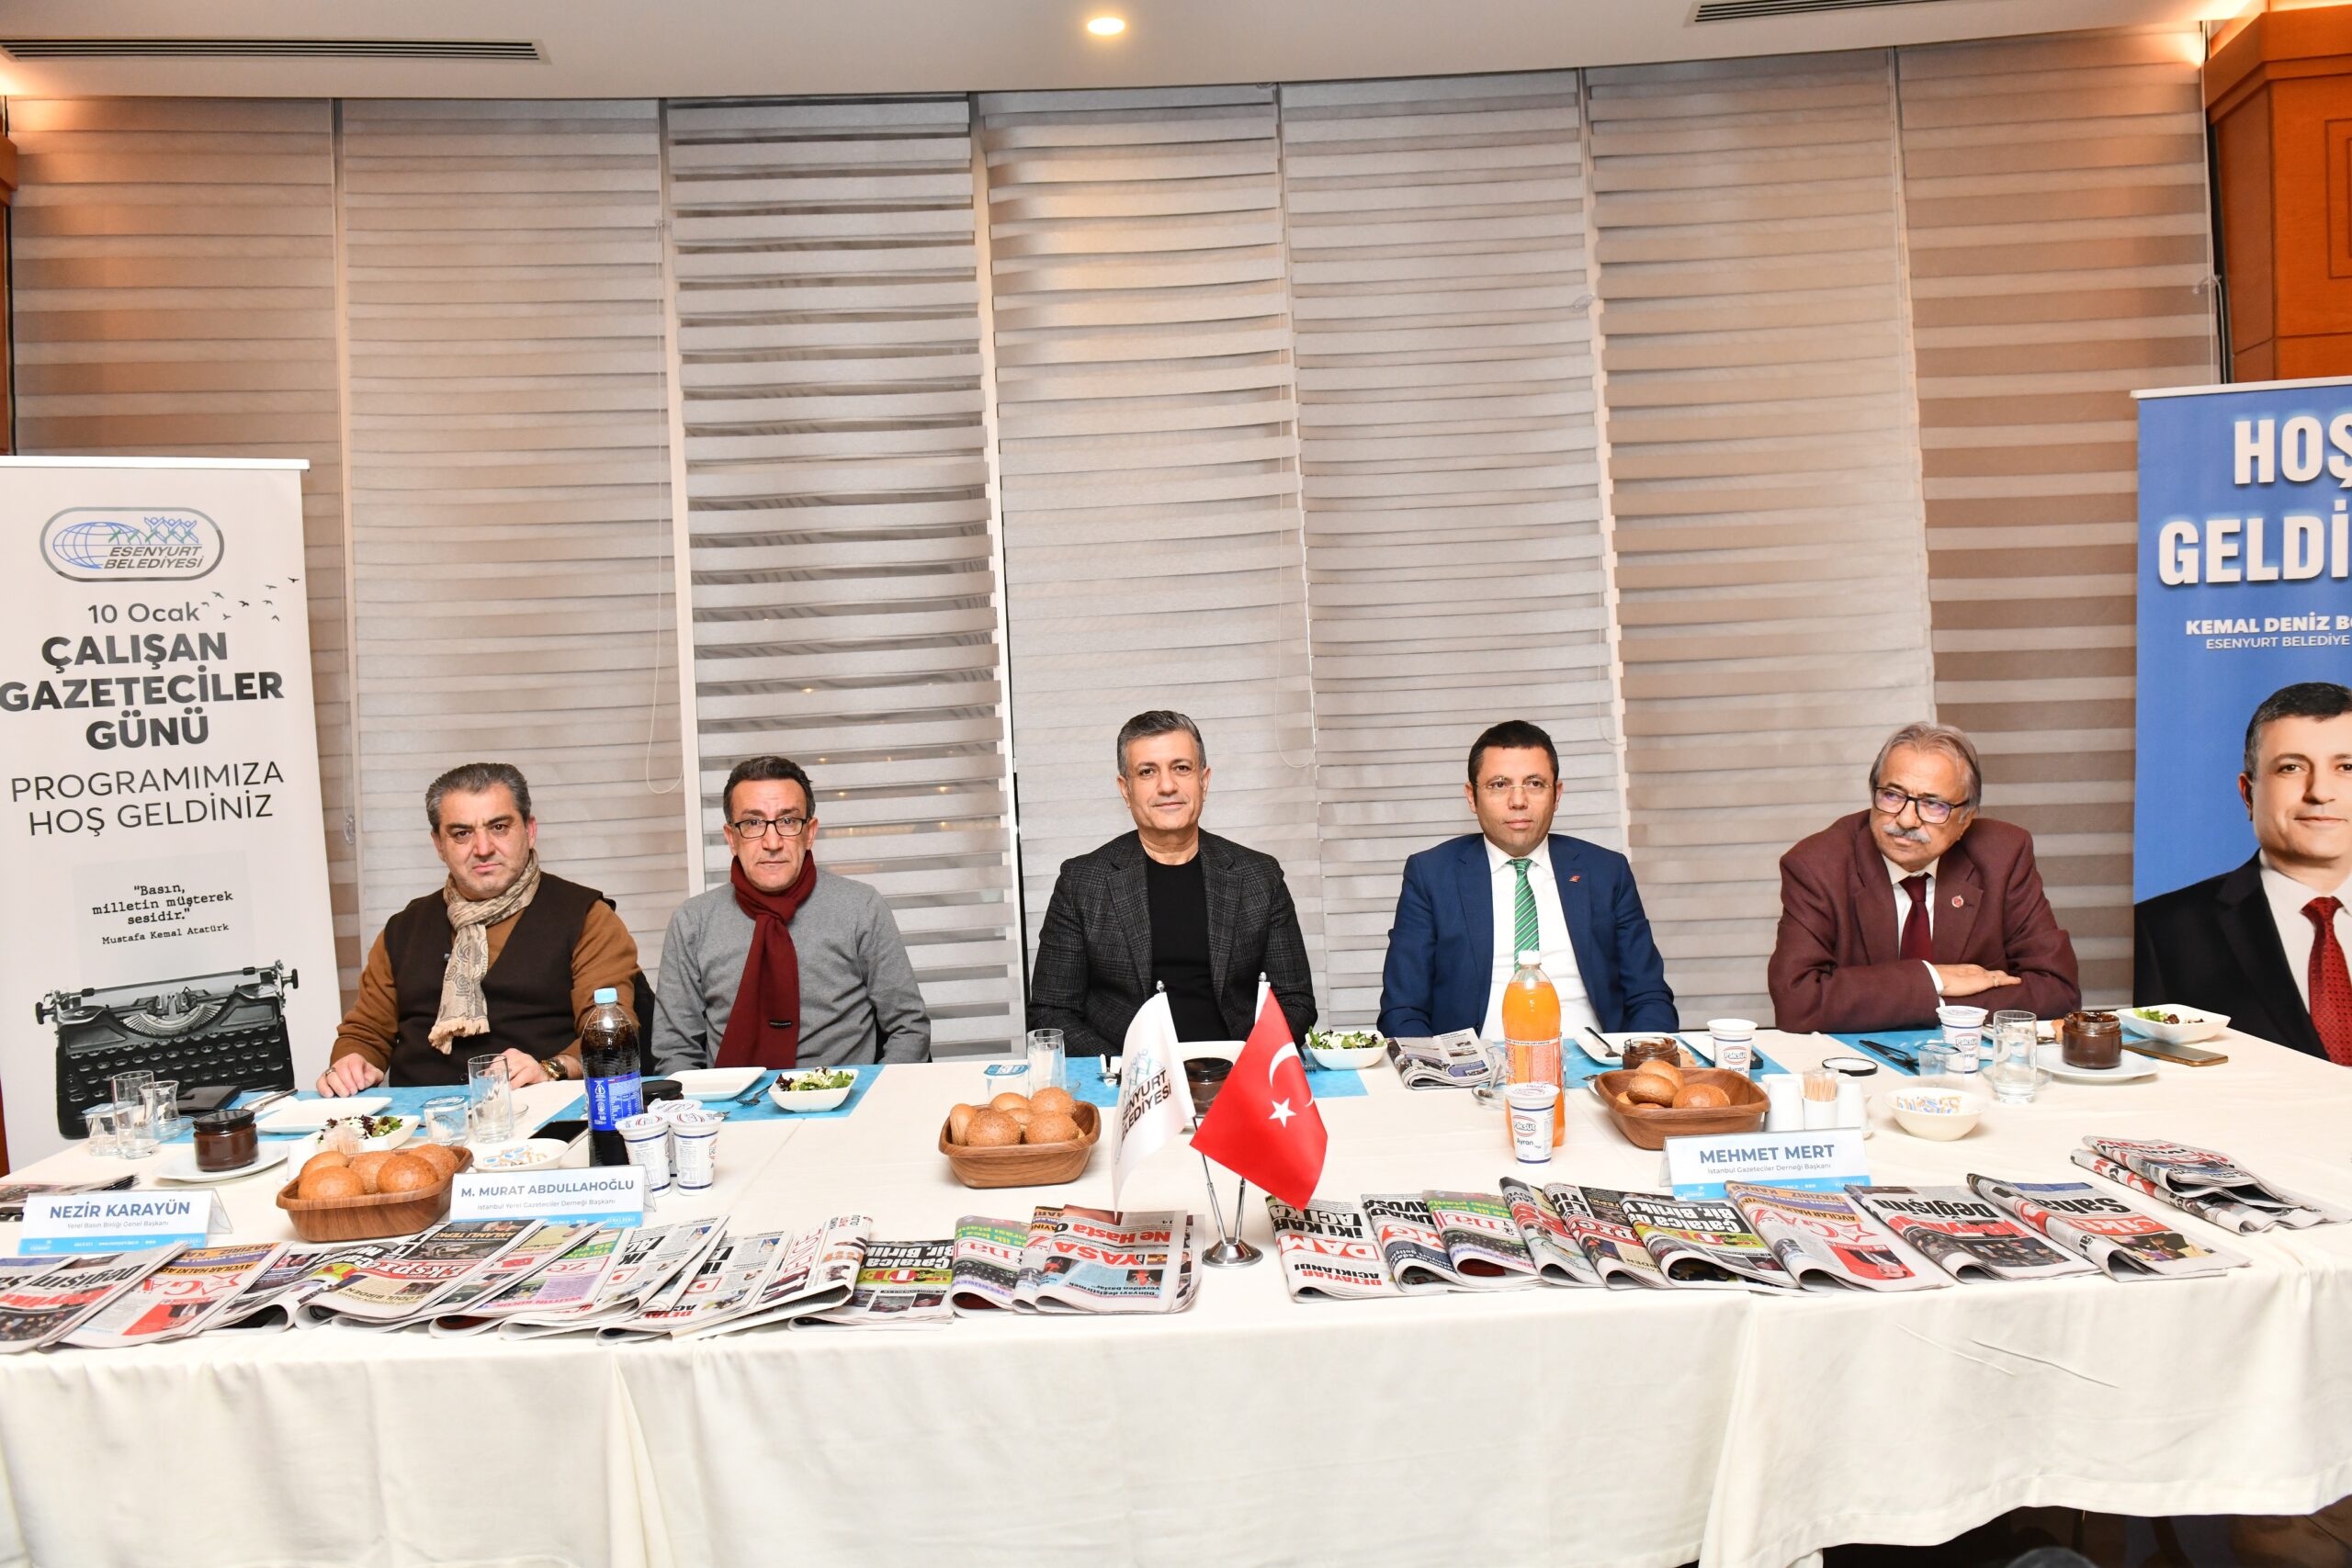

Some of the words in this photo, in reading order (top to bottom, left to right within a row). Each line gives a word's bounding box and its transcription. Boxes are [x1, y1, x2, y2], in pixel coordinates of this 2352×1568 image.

[109, 546, 203, 557] ESENYURT
[2159, 499, 2349, 586] GELDİ
[104, 555, 205, 570] BELEDİYESİ
[88, 604, 118, 624] 10
[128, 602, 200, 623] Ocak
[2186, 617, 2259, 635] KEMAL
[2264, 611, 2330, 632] DENİZ
[2335, 615, 2352, 630] B
[2206, 637, 2278, 649] ESENYURT
[2282, 633, 2350, 647] BELEDİYE
[41, 632, 228, 673] ÇALIŞAN
[0, 665, 285, 712] GAZETECİLER
[85, 706, 209, 750] GÜNÜ
[11, 761, 285, 802] PROGRAMIMIZA
[29, 807, 106, 837] HOŞ
[117, 790, 273, 828] GELDİNİZ
[92, 898, 159, 915] milletin
[166, 891, 233, 908] müşterek
[102, 932, 146, 945] Mustafa
[150, 929, 183, 940] Kemal
[187, 923, 230, 936] Atatürk
[1700, 1146, 1779, 1164] MEHMET
[1785, 1144, 1834, 1160] MERT
[1737, 1165, 1774, 1174] Gazeteciler
[1776, 1163, 1804, 1172] Derneği
[1804, 1162, 1831, 1171] Başkanı
[461, 1188, 475, 1198] M.
[479, 1185, 526, 1197] MURAT
[527, 1179, 635, 1195] ABDULLAHOĞLU
[50, 1201, 100, 1219] NEZİR
[106, 1199, 191, 1217] KARAYÜN
[1871, 1198, 2000, 1219] Değişim
[1073, 1224, 1136, 1244] Hasta
[1139, 1231, 1171, 1242] Ne
[1055, 1242, 1141, 1265] YASA
[210, 1263, 253, 1273] AVCILAR
[1302, 1270, 1382, 1286] DETAYLAR
